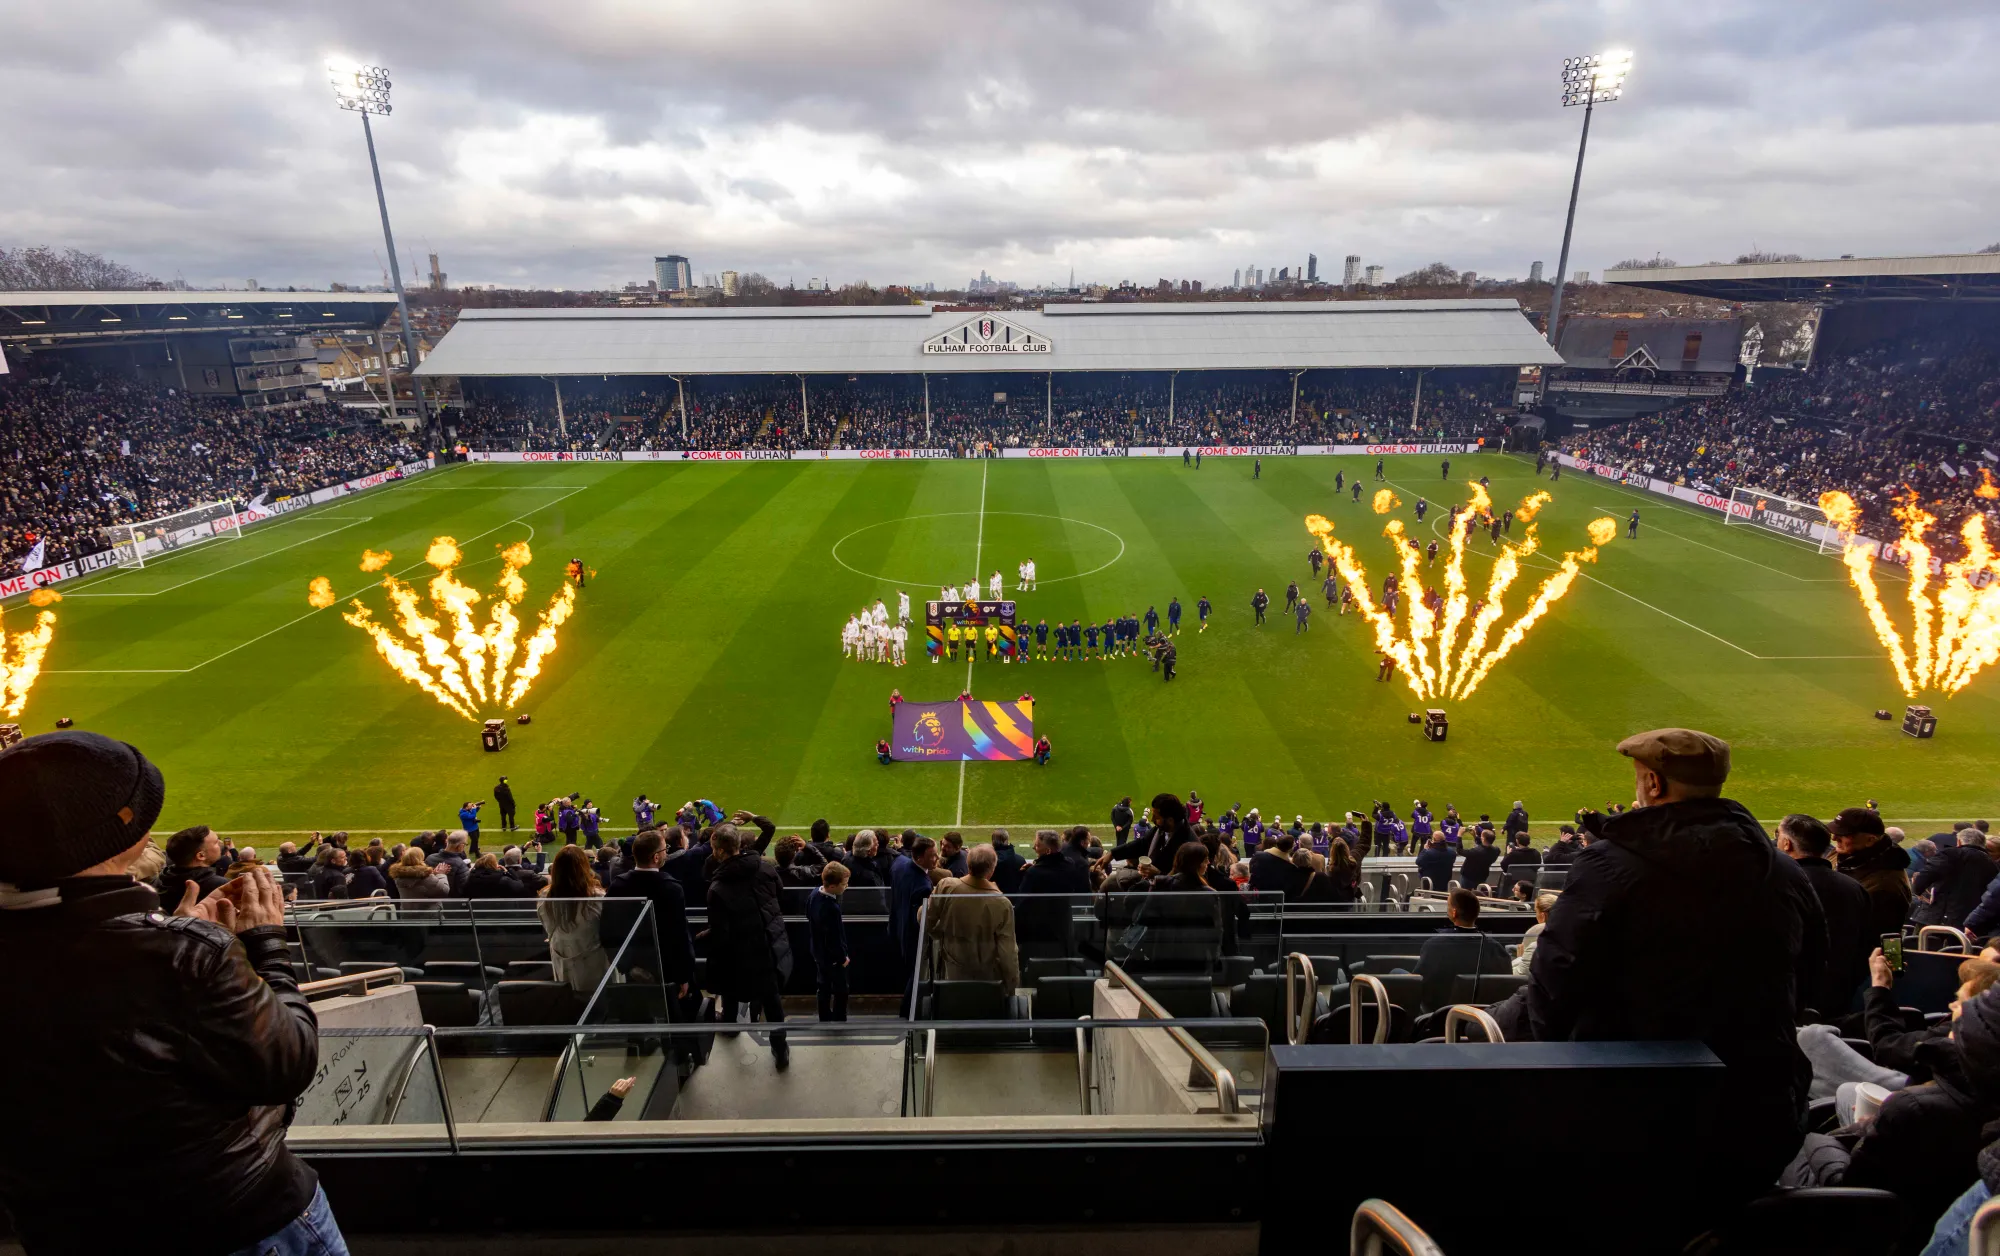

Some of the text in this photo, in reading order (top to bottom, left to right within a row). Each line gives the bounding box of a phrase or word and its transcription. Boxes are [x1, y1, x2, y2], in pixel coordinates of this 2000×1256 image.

[1022, 344, 1047, 352] CLUB
[860, 449, 891, 458] COME
[913, 449, 949, 458] FULHA
[1028, 448, 1060, 457] COME
[1062, 448, 1079, 457] ON
[1198, 446, 1295, 456] COME ON FULHAM
[1366, 444, 1464, 454] COME ON FULHAM
[522, 452, 553, 461] COME
[576, 452, 620, 461] FULHAM
[691, 450, 788, 460] COME ON FULHAM
[359, 461, 428, 489] COME ON ULHAM
[1598, 465, 1612, 477] ON
[1696, 493, 1808, 535] COME ON ULHAM
[210, 513, 246, 533] COME
[0, 576, 29, 596] ME
[32, 566, 62, 588] ON
[902, 745, 952, 756] with pride
[1417, 815, 1429, 824] 10
[1445, 827, 1453, 835] 4
